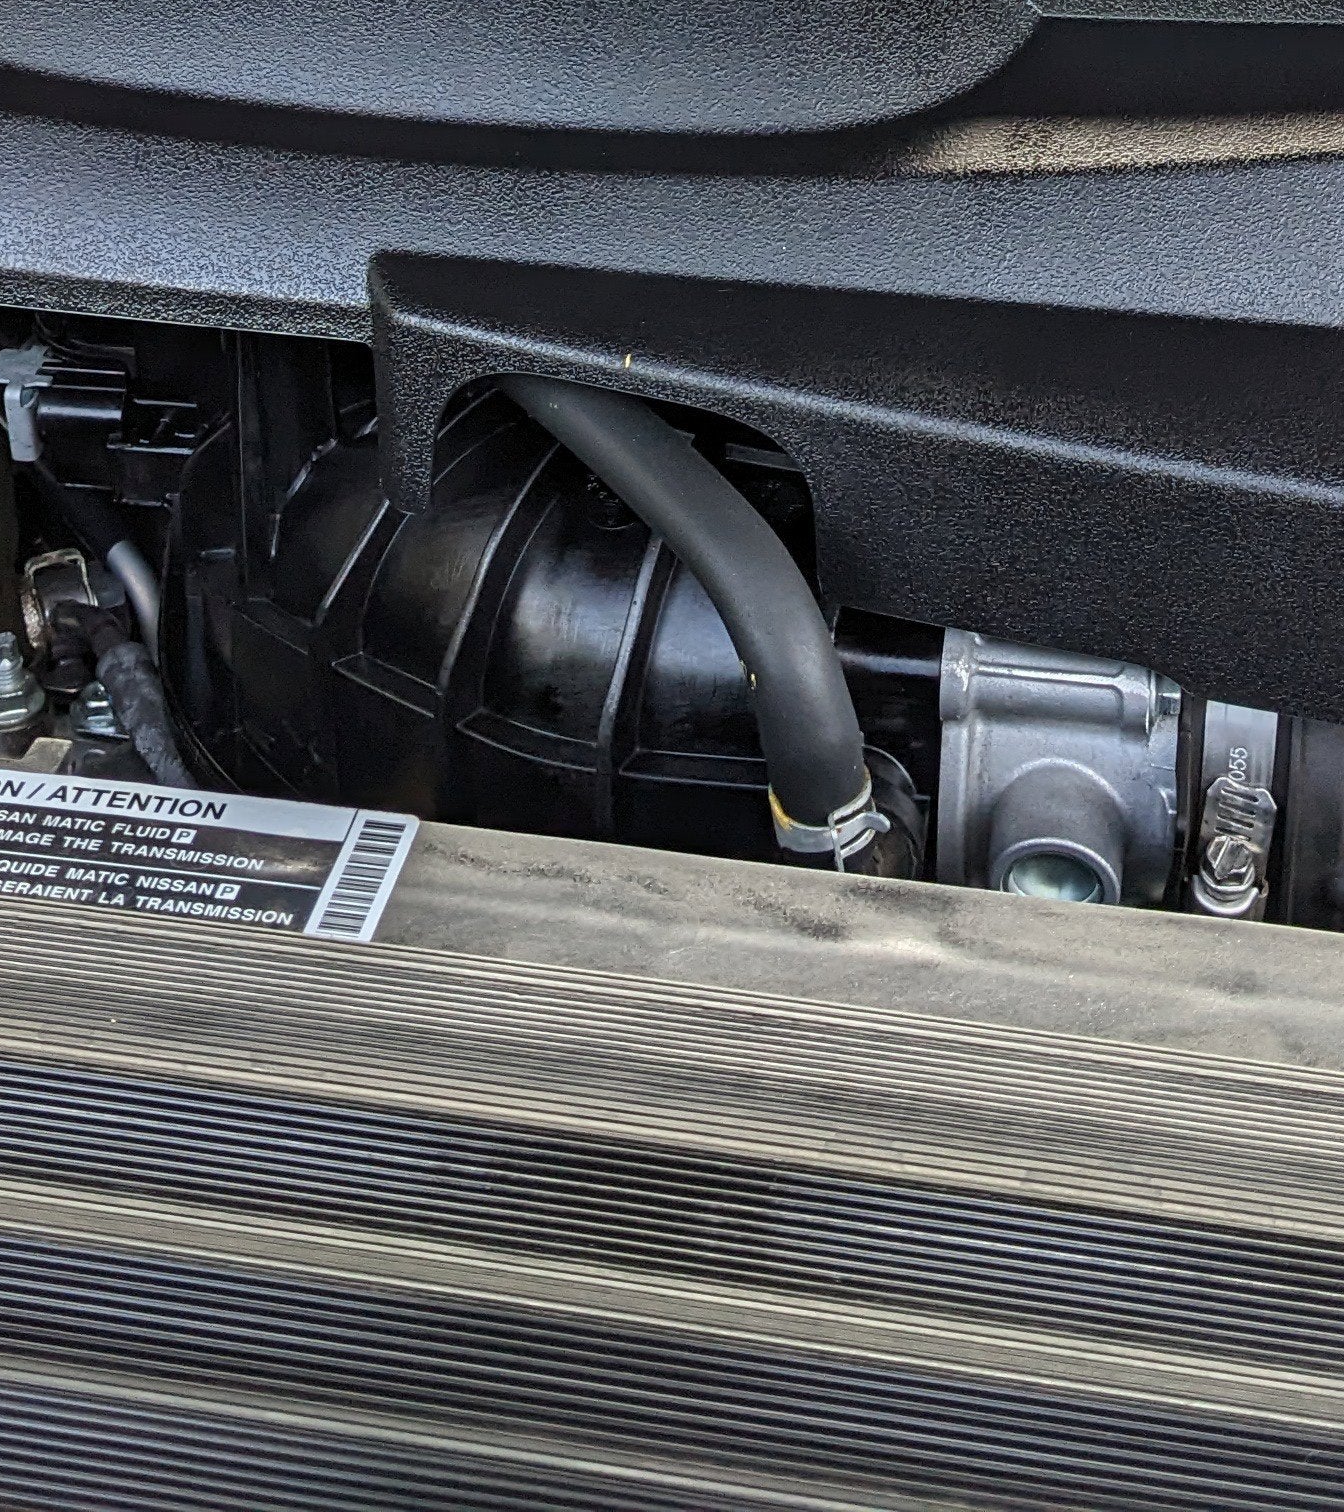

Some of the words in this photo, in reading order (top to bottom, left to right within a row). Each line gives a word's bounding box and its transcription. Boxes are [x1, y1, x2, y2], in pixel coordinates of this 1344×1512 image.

[46, 785, 227, 820] ATTENTION
[42, 814, 106, 832] MATIC
[63, 836, 103, 851] THE
[110, 841, 265, 871] TRANSMISSION
[65, 868, 130, 885] MATIC
[98, 891, 125, 906] LA
[135, 895, 294, 926] TRANSMISSION
